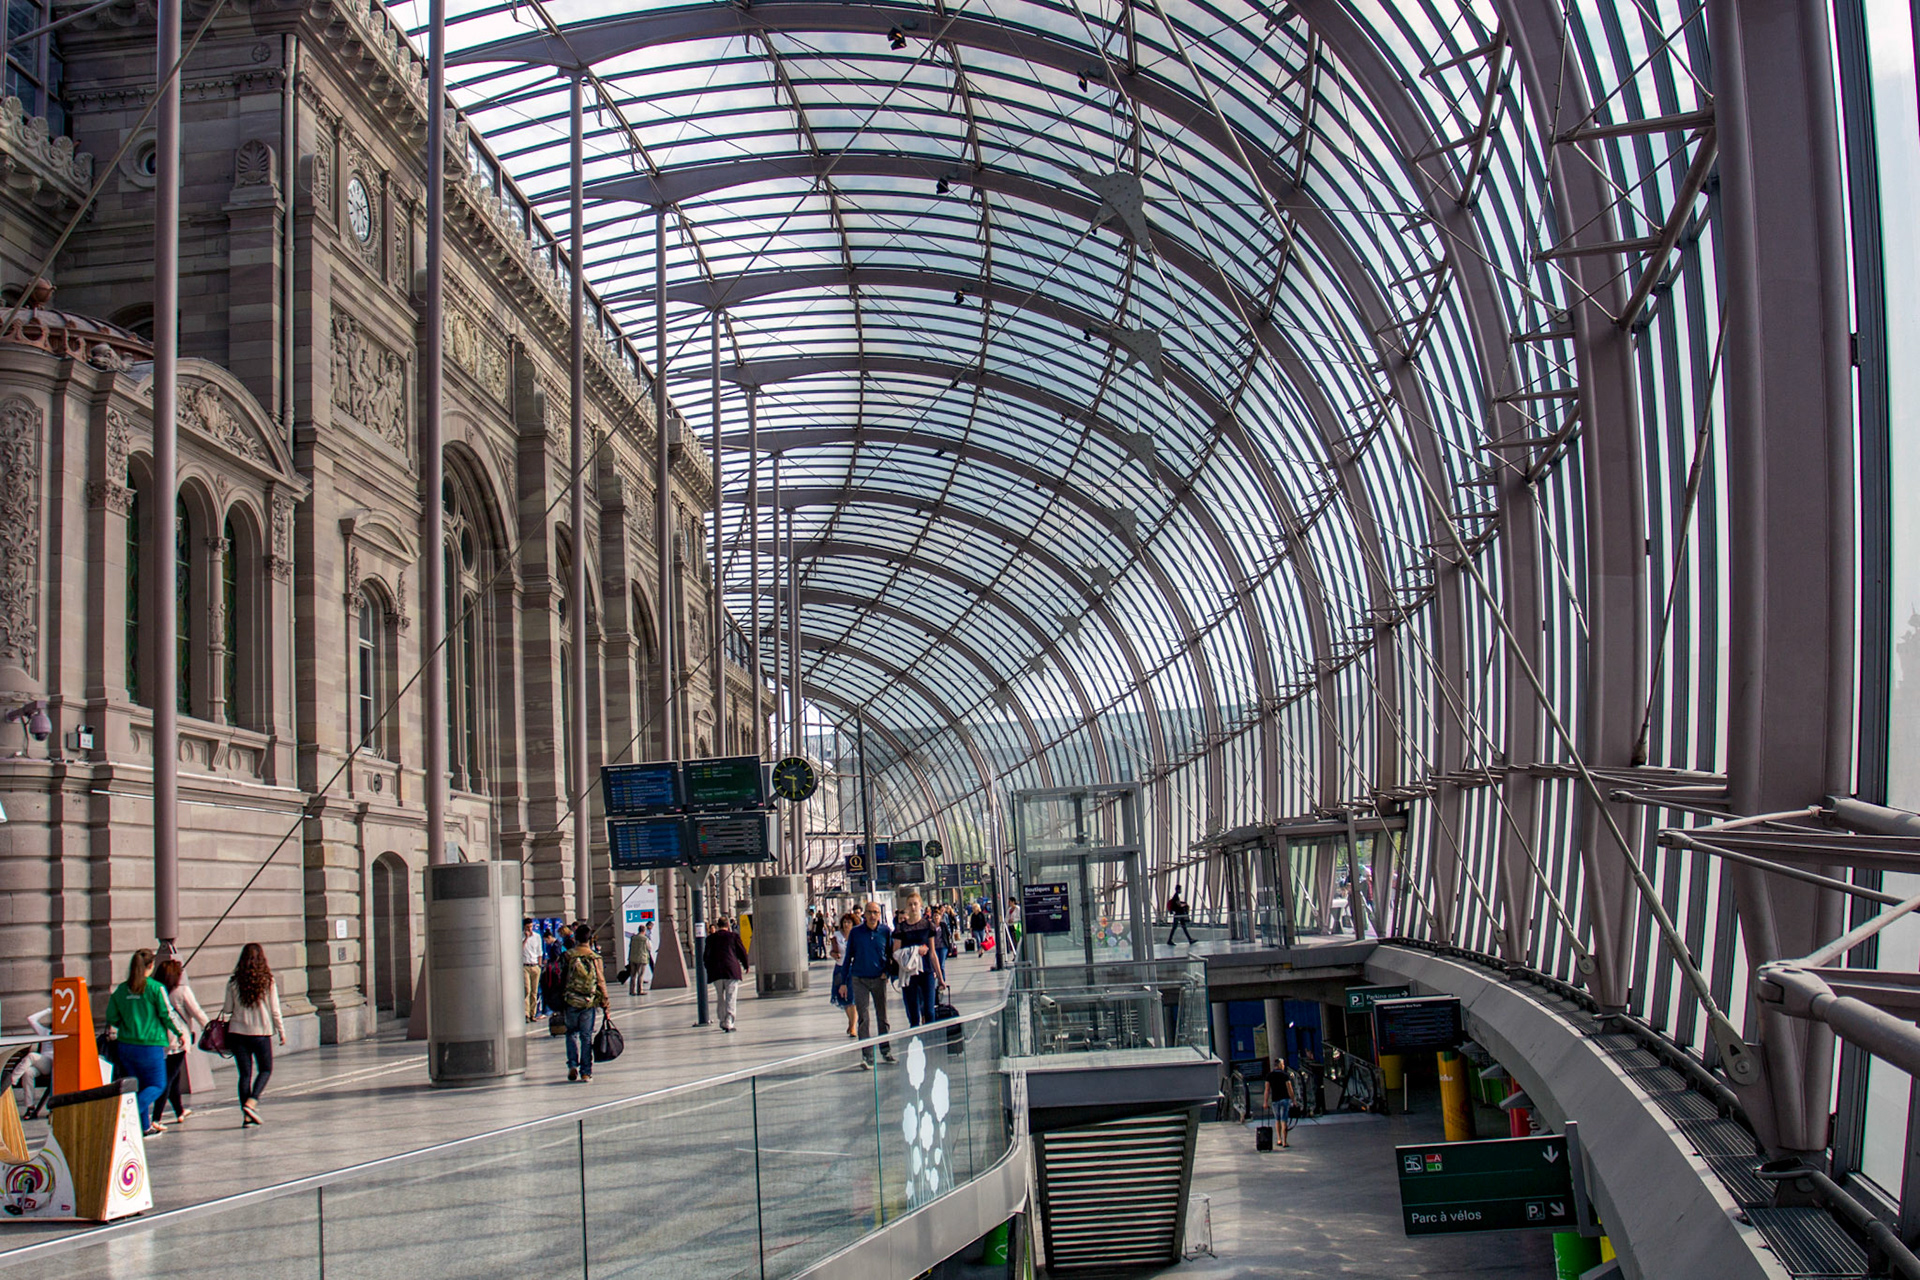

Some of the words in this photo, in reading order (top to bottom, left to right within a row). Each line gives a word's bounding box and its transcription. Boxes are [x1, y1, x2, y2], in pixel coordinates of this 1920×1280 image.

[1351, 996, 1360, 1006] P
[1434, 1154, 1441, 1162] A
[1435, 1163, 1442, 1171] D
[1411, 1212, 1437, 1224] Parc
[1440, 1211, 1447, 1222] à
[1450, 1210, 1482, 1222] vélos
[1528, 1205, 1538, 1218] P
